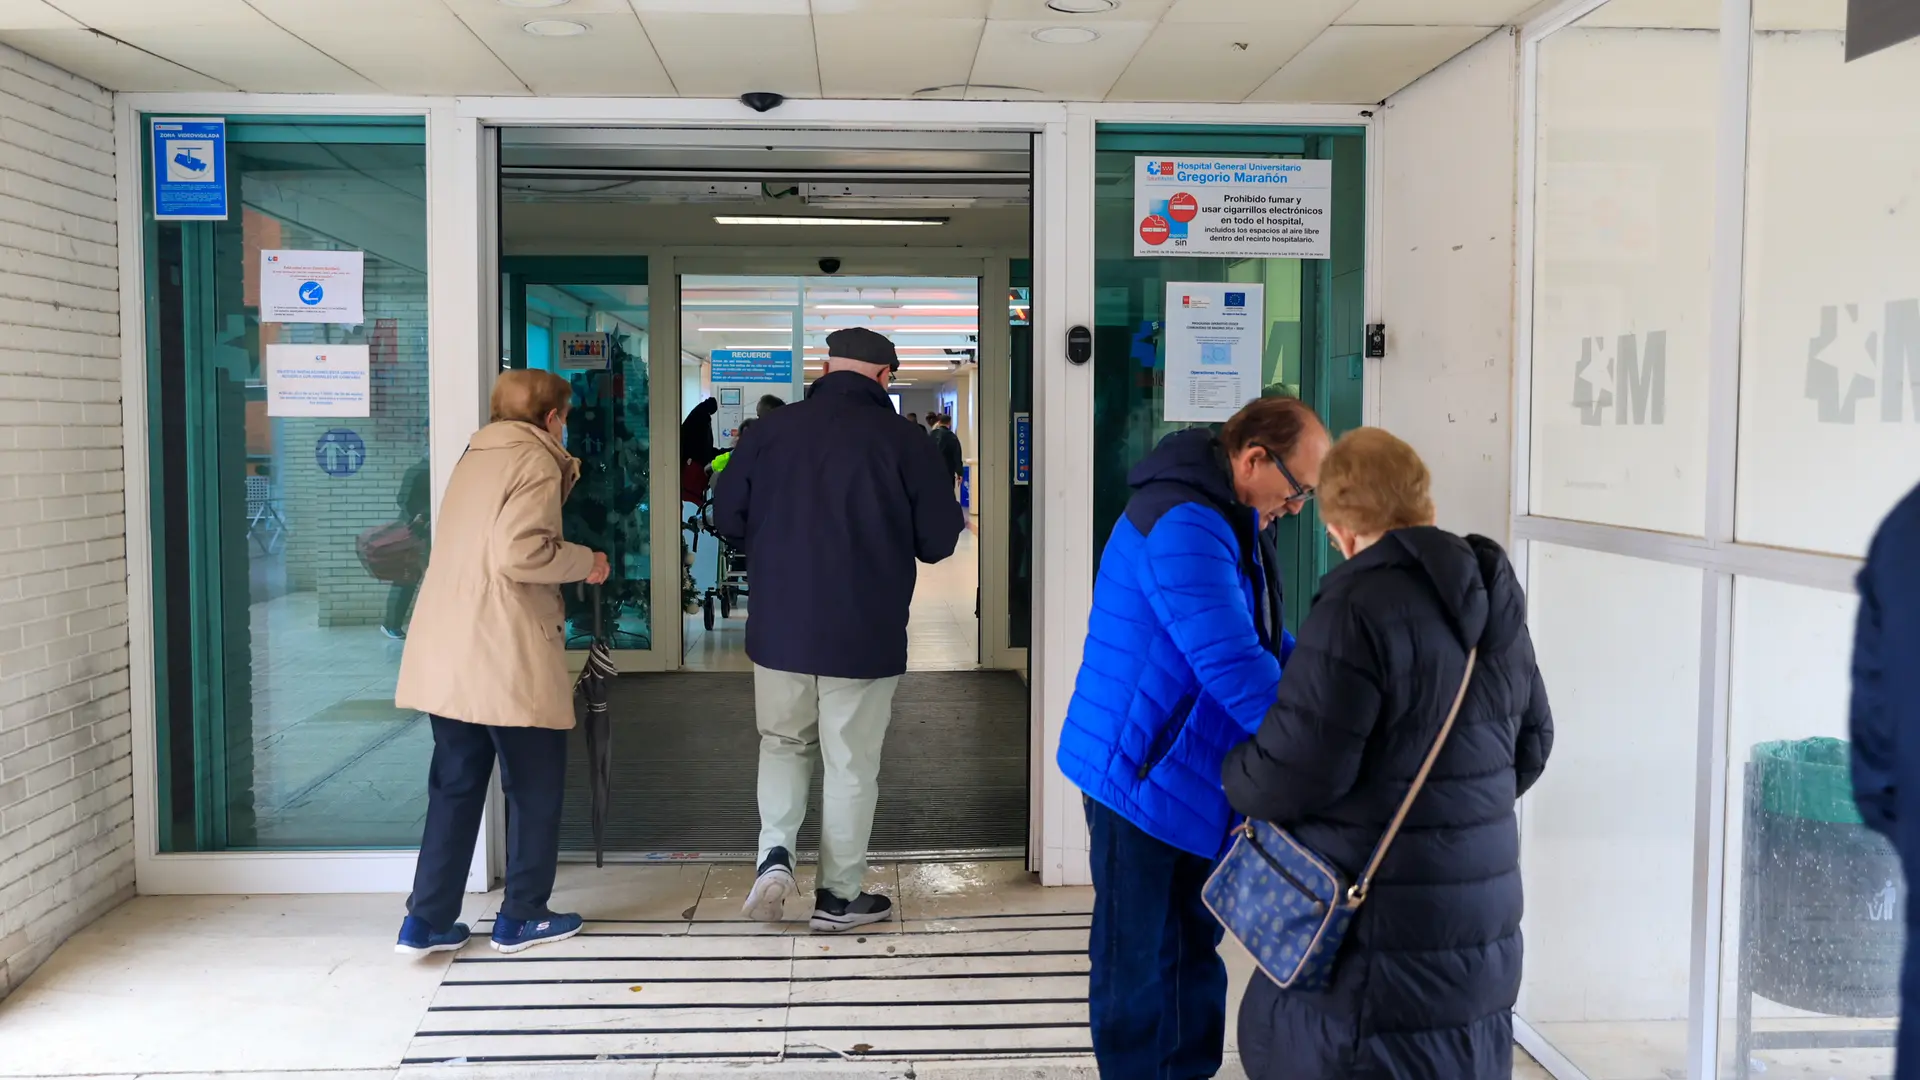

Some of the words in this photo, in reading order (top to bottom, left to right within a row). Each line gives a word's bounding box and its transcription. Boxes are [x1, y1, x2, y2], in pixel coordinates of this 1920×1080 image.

[1177, 162, 1212, 171] Hospital
[1249, 163, 1301, 172] Universitario
[1177, 172, 1230, 184] Gregorio
[1234, 172, 1288, 183] Marañón
[1224, 195, 1266, 203] Prohibido
[1296, 197, 1302, 205] y
[1224, 206, 1266, 216] cigarrillos
[1269, 206, 1323, 215] electrónicos
[1267, 217, 1304, 226] hospital,
[1272, 236, 1314, 244] hospitalario.
[1616, 330, 1666, 425] M
